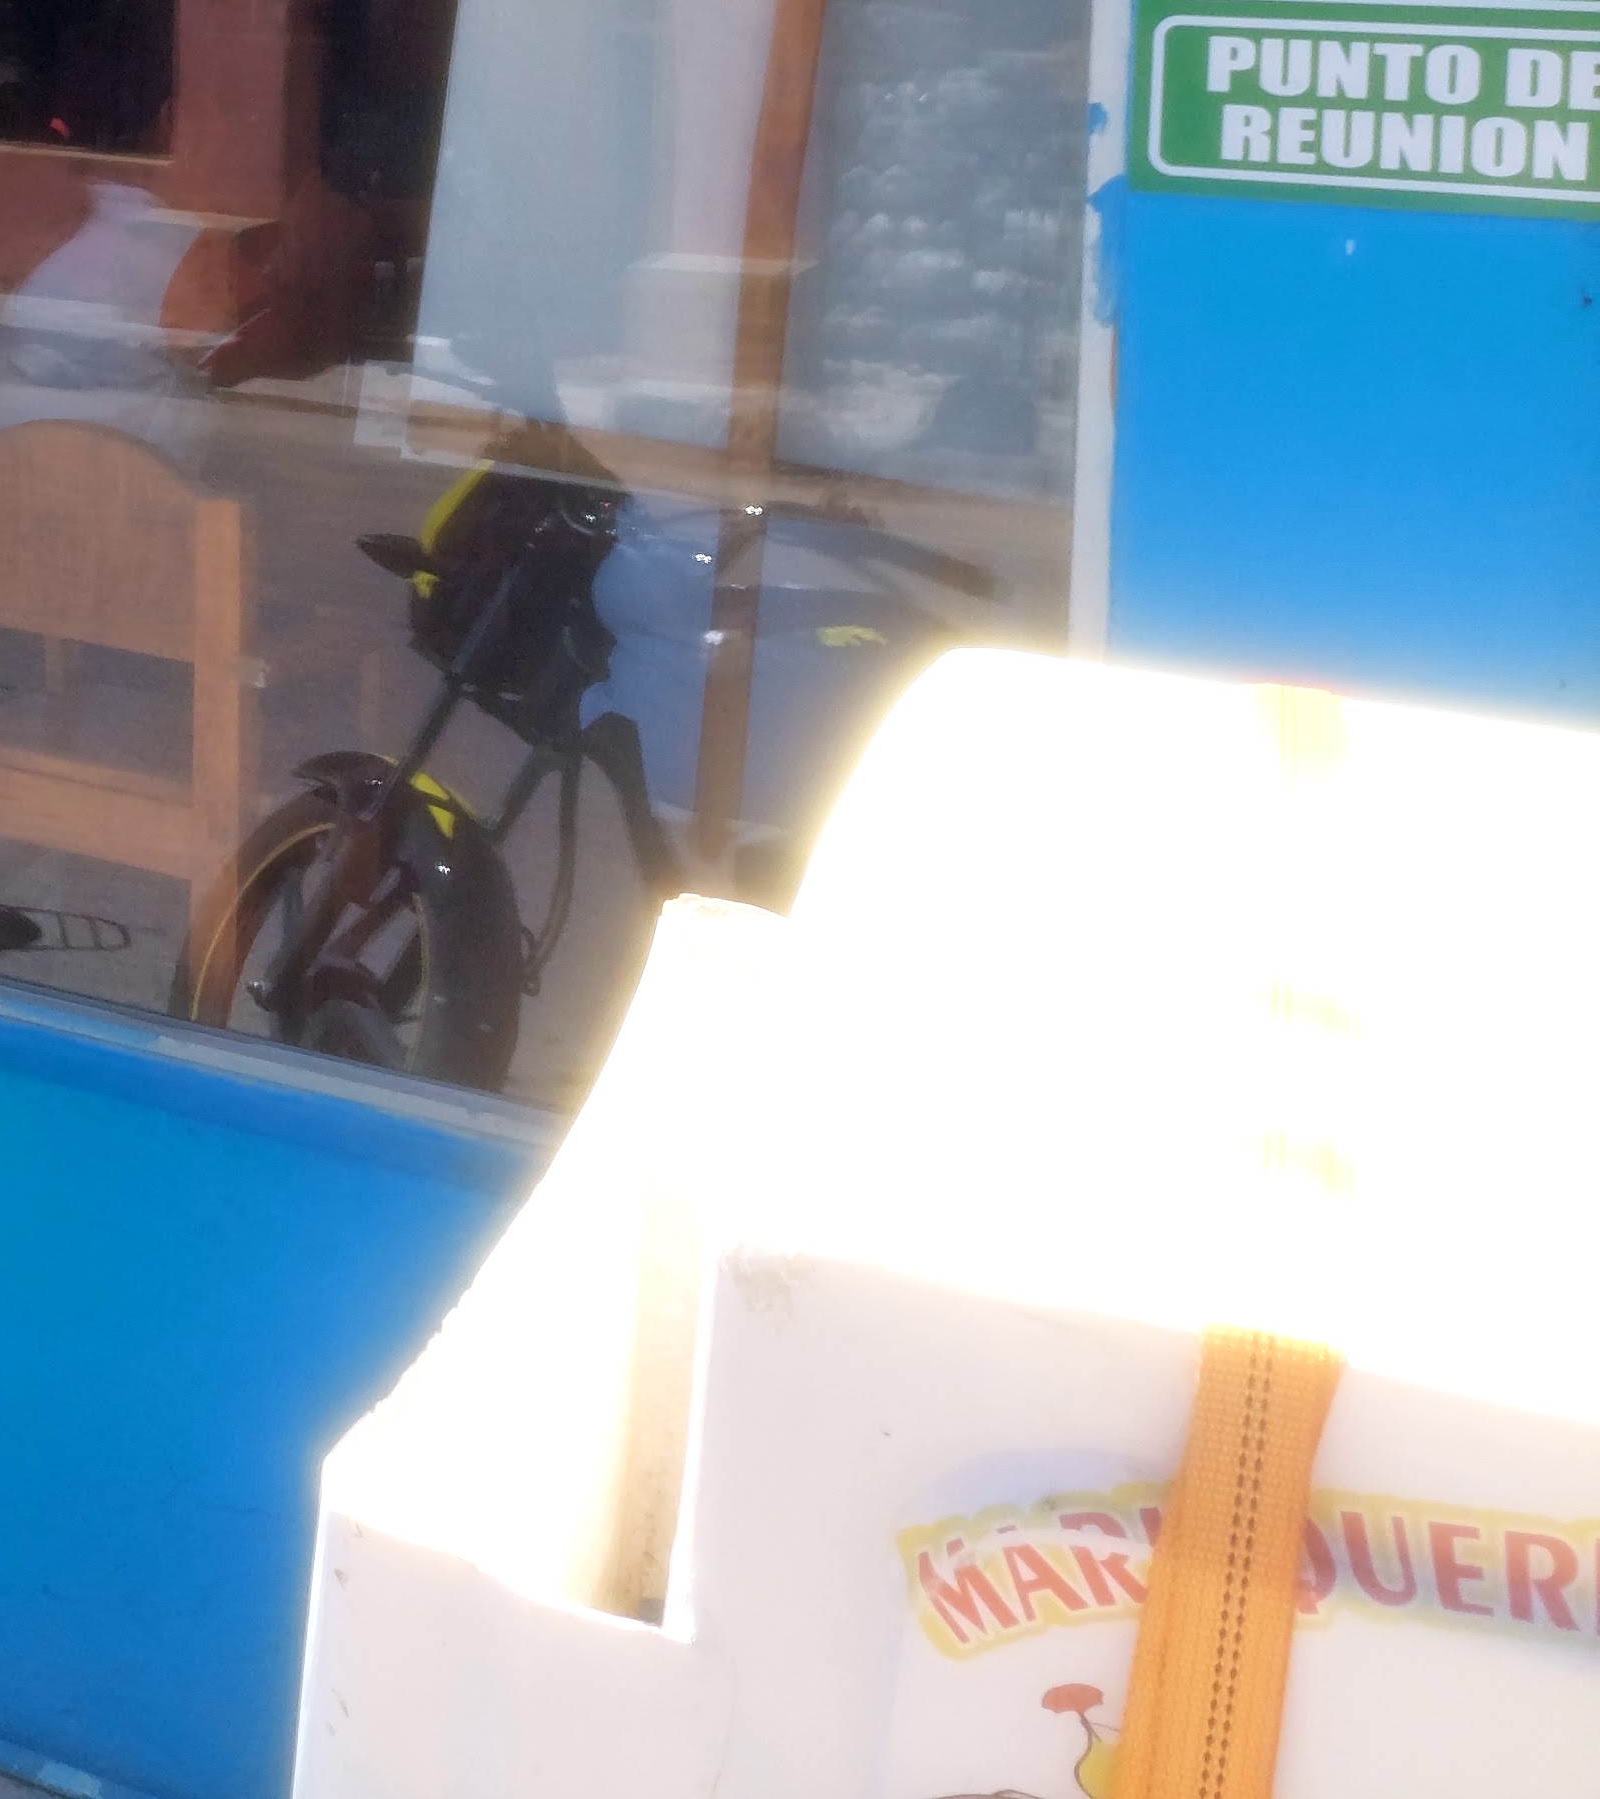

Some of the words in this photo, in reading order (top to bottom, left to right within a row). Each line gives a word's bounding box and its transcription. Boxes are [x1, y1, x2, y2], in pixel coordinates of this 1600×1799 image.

[1206, 35, 1481, 104] PUNTO
[1504, 47, 1600, 111] DE
[1219, 103, 1589, 181] REUNION
